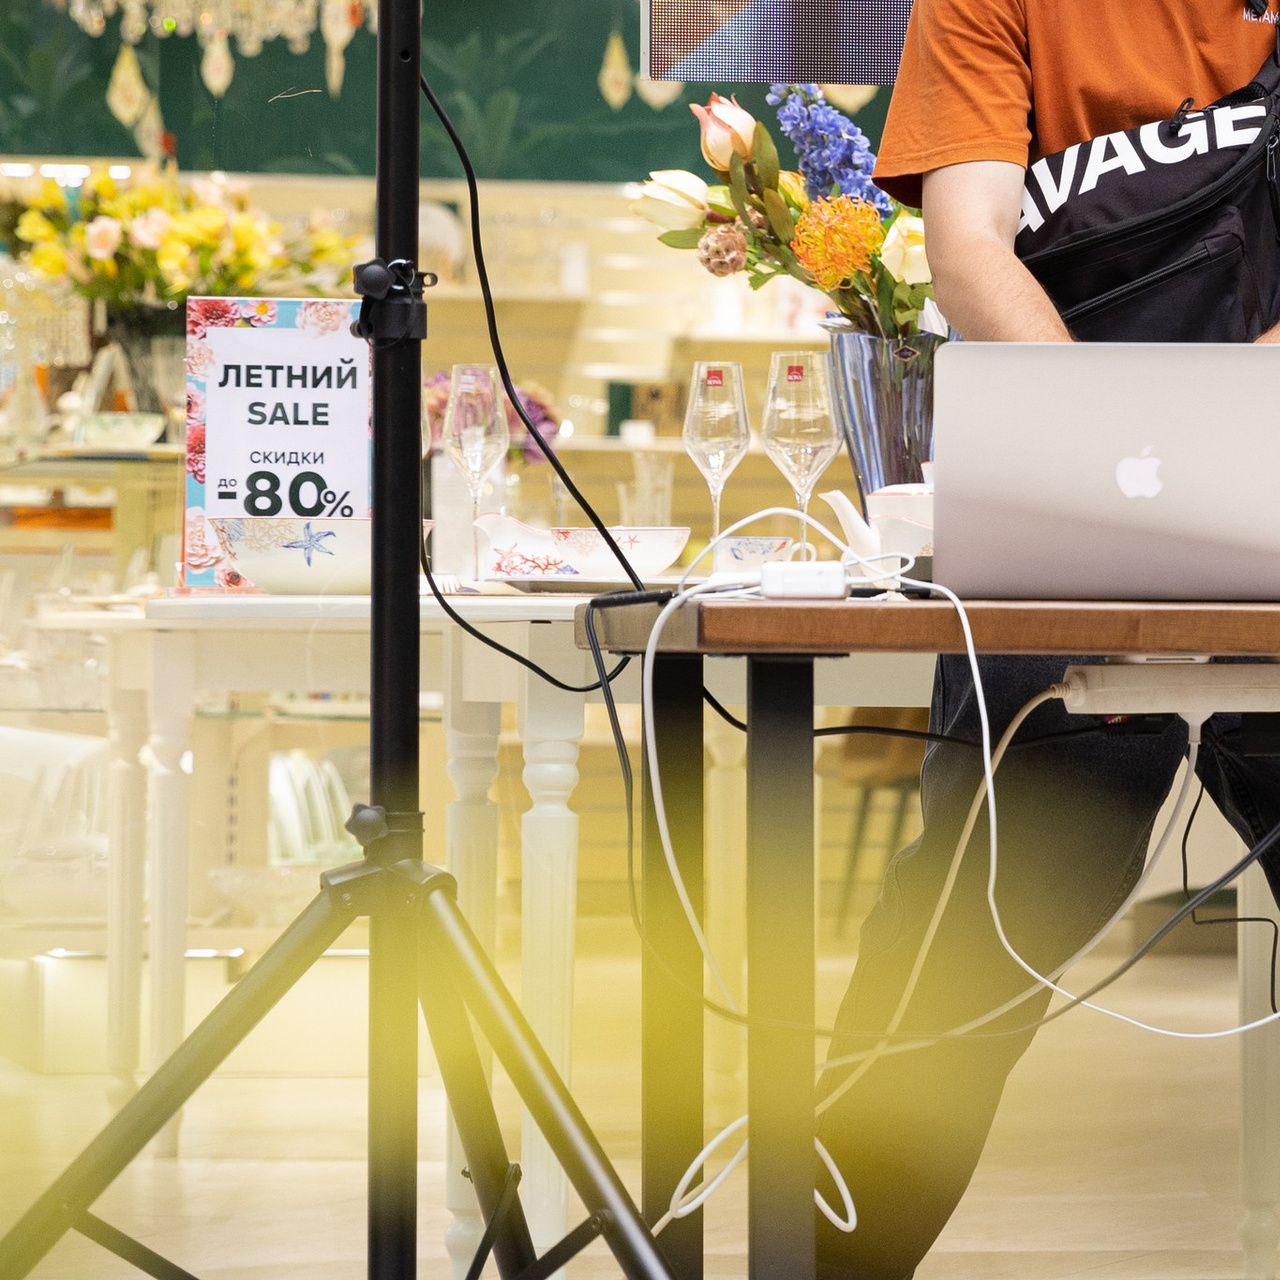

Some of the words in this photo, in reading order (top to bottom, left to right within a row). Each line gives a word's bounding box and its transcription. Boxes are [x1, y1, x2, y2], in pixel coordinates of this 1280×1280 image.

[218, 358, 357, 389] ЛЕТНИЙ
[248, 401, 329, 426] SALE
[218, 478, 237, 488] до
[218, 471, 353, 517] -80%
